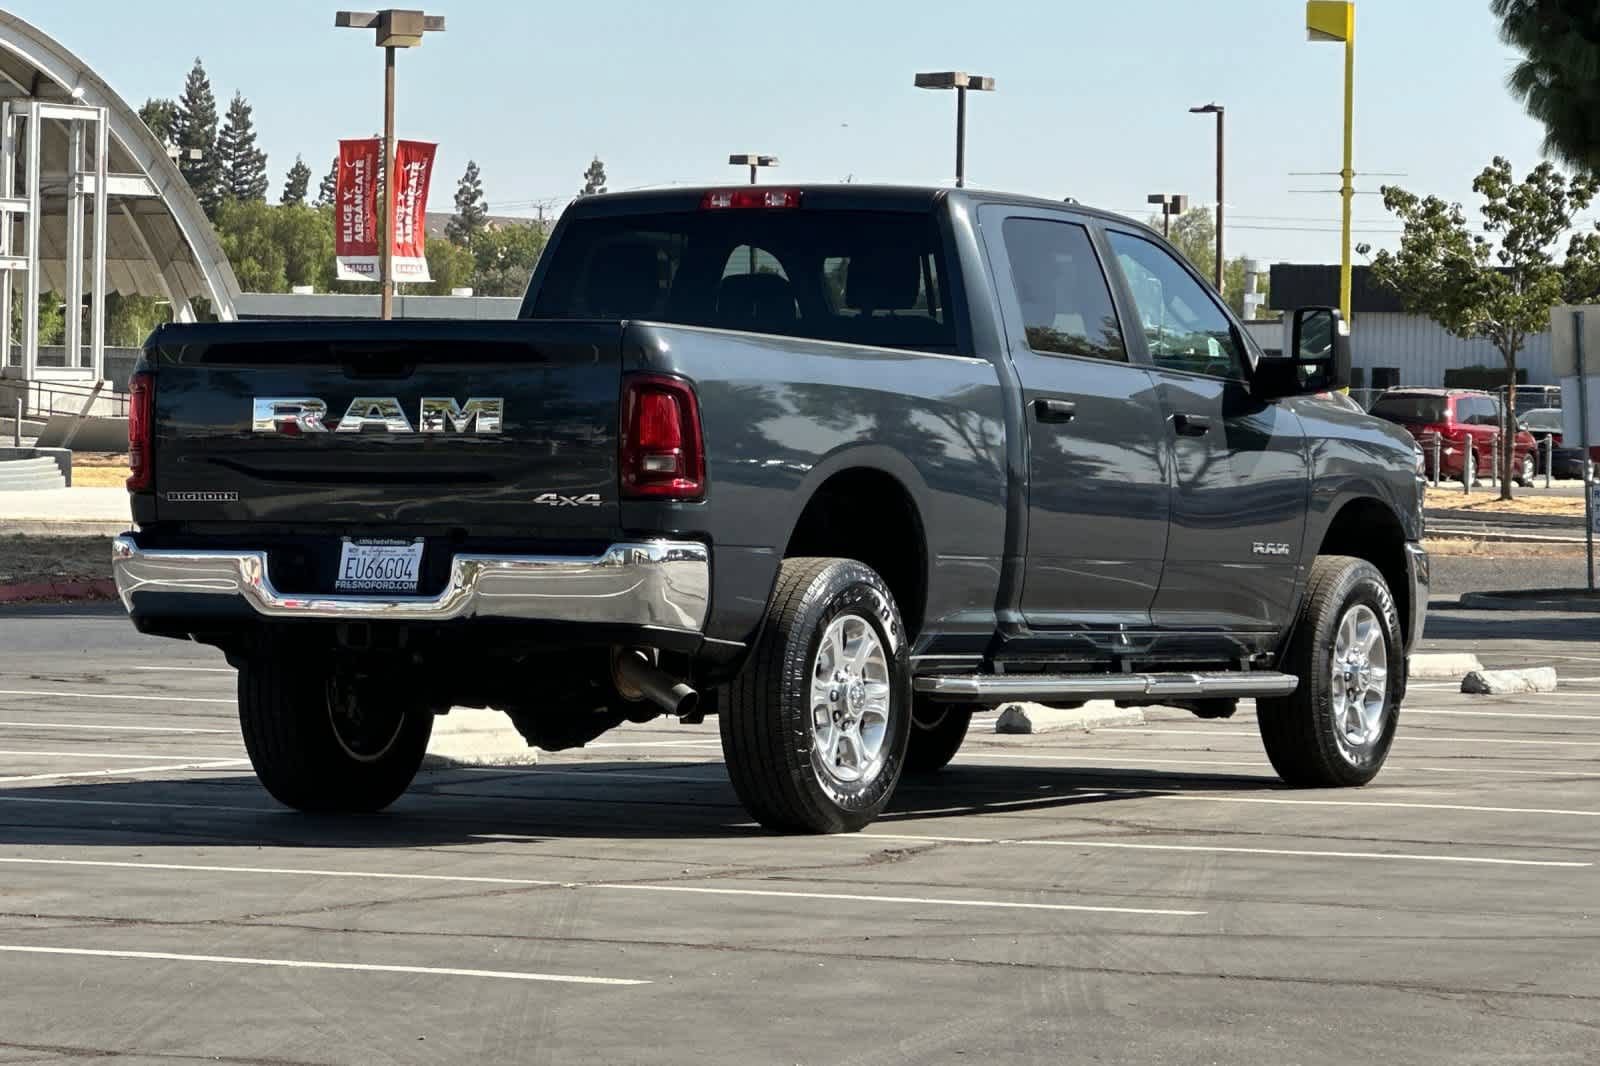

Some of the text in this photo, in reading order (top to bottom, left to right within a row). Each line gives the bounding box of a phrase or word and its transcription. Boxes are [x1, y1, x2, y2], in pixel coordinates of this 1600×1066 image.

[344, 203, 352, 242] ELIGE
[251, 397, 504, 433] RAM
[345, 557, 412, 579] EU66G04
